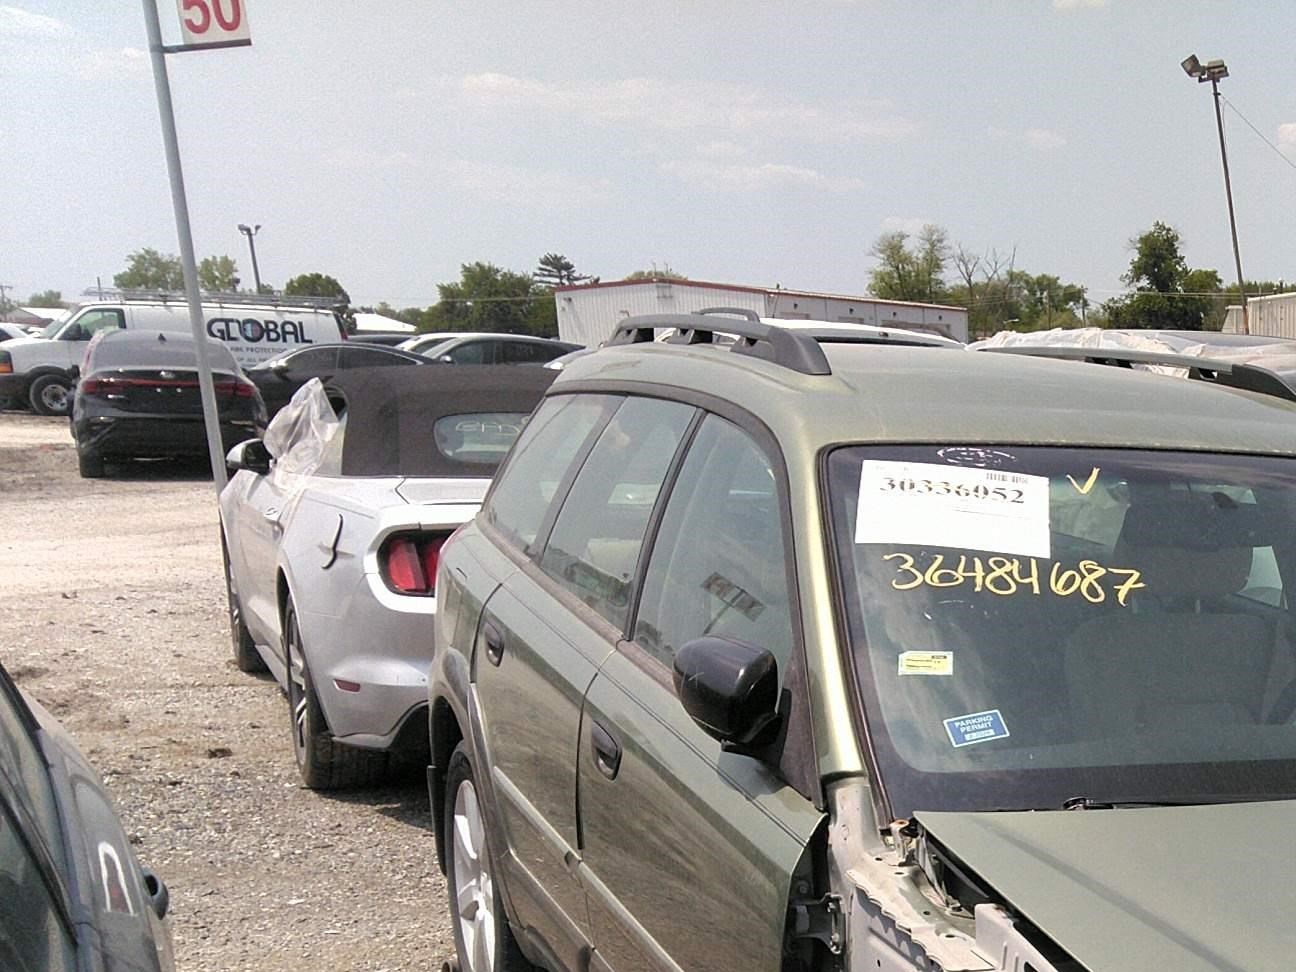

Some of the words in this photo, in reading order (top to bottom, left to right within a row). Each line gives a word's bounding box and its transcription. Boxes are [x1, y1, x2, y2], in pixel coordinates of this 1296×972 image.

[182, 0, 241, 34] 50
[207, 317, 313, 344] GLOBAL
[879, 476, 1025, 505] 30336052
[882, 552, 1146, 607] 36484687
[954, 714, 994, 729] PARKING
[960, 721, 993, 733] PERMIT
